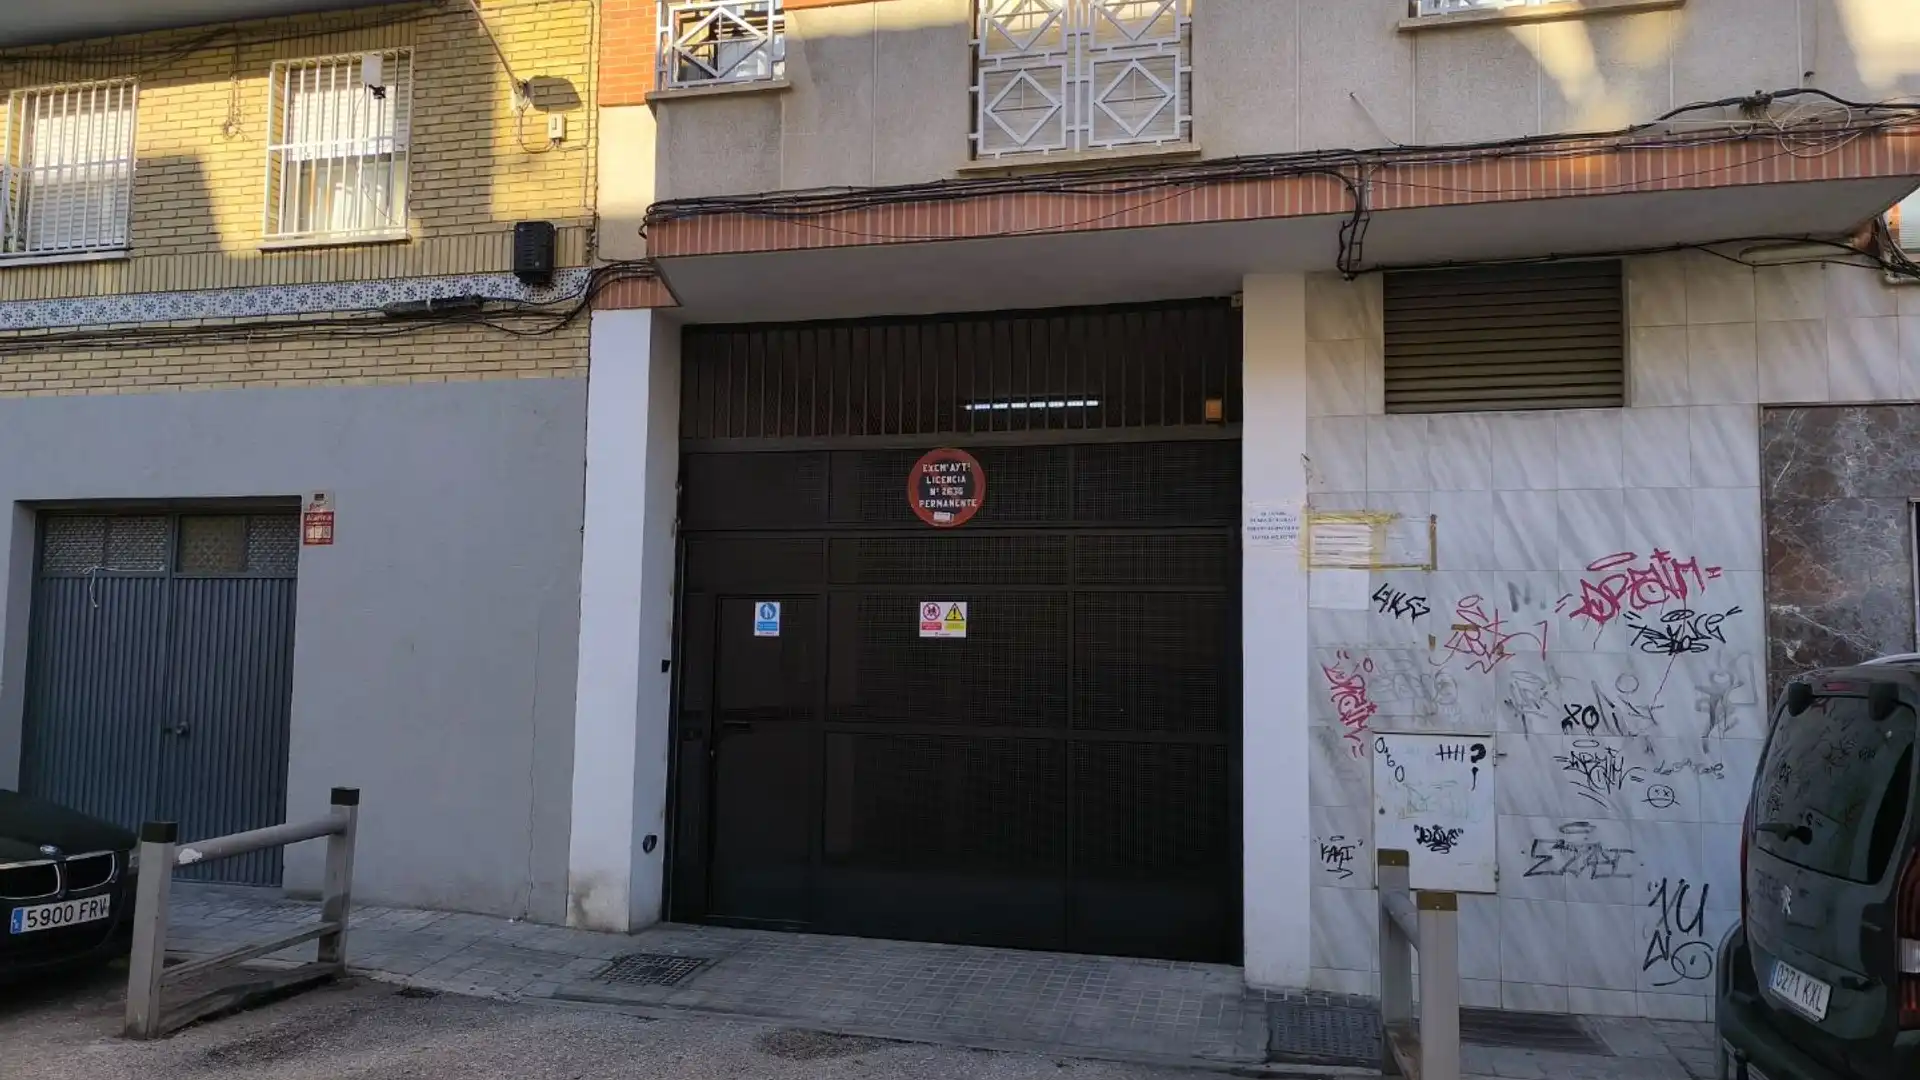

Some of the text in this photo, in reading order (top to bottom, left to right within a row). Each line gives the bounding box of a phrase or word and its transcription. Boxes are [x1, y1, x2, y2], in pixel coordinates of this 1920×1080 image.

[926, 476, 966, 485] LICENCIA
[919, 498, 977, 508] PERMANENTE
[27, 905, 74, 928] 5900
[1777, 964, 1800, 998] 0271
